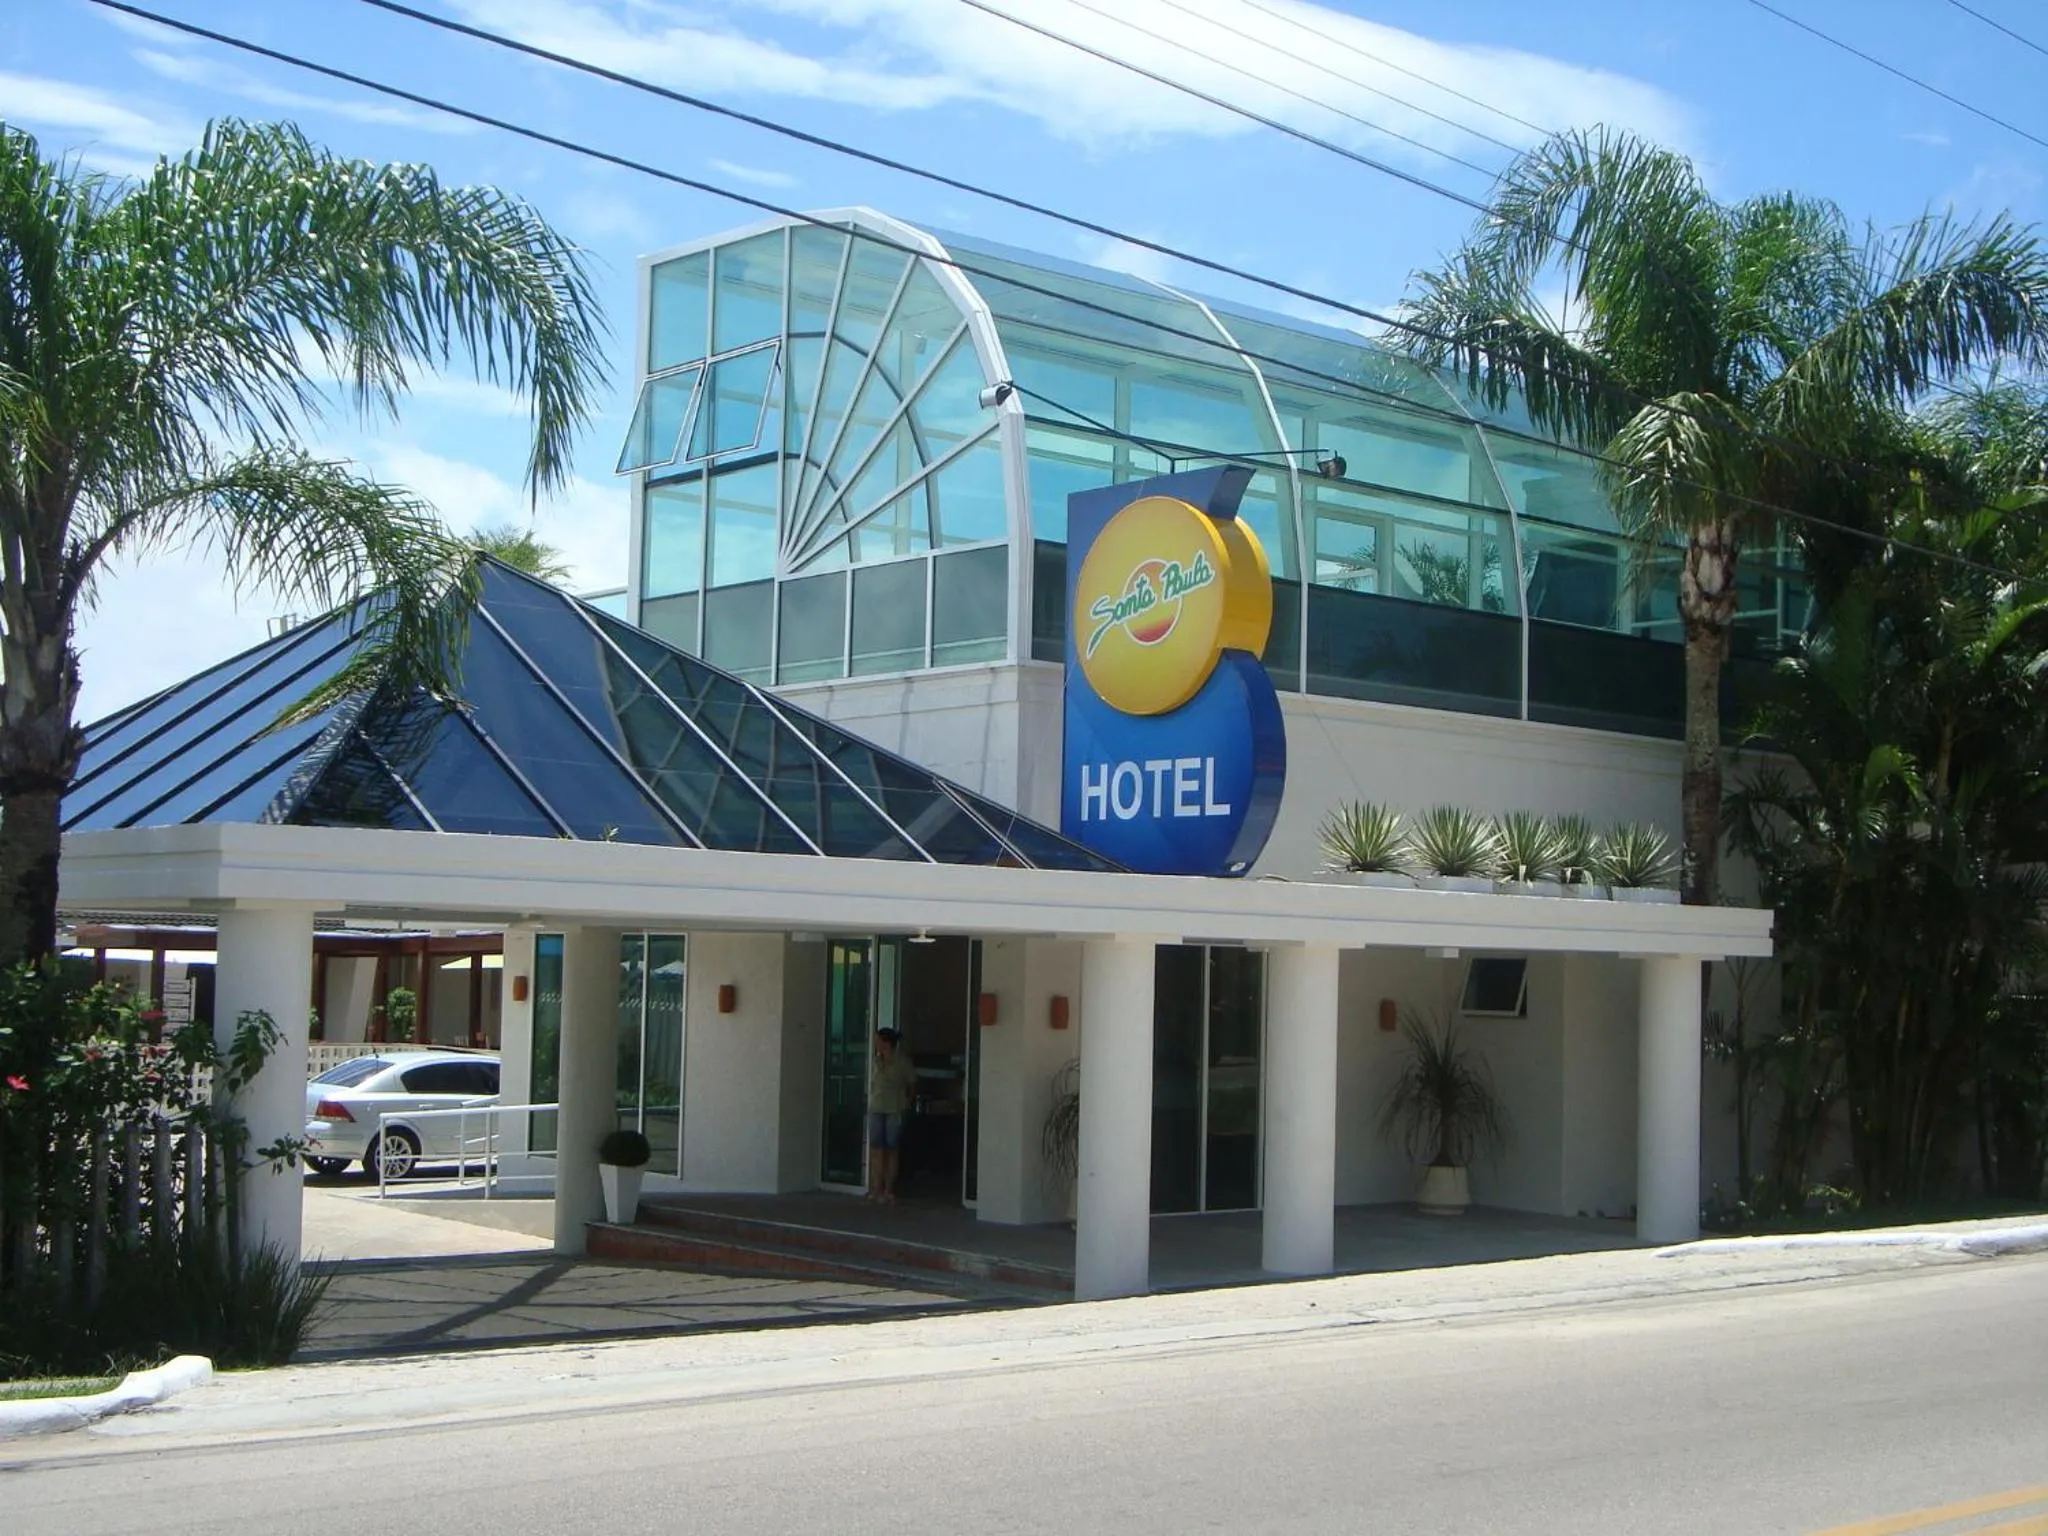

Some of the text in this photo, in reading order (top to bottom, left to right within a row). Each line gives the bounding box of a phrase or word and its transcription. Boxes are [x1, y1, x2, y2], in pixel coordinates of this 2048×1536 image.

[1088, 551, 1215, 658] Santa Paula
[1081, 757, 1231, 821] HOTEL
